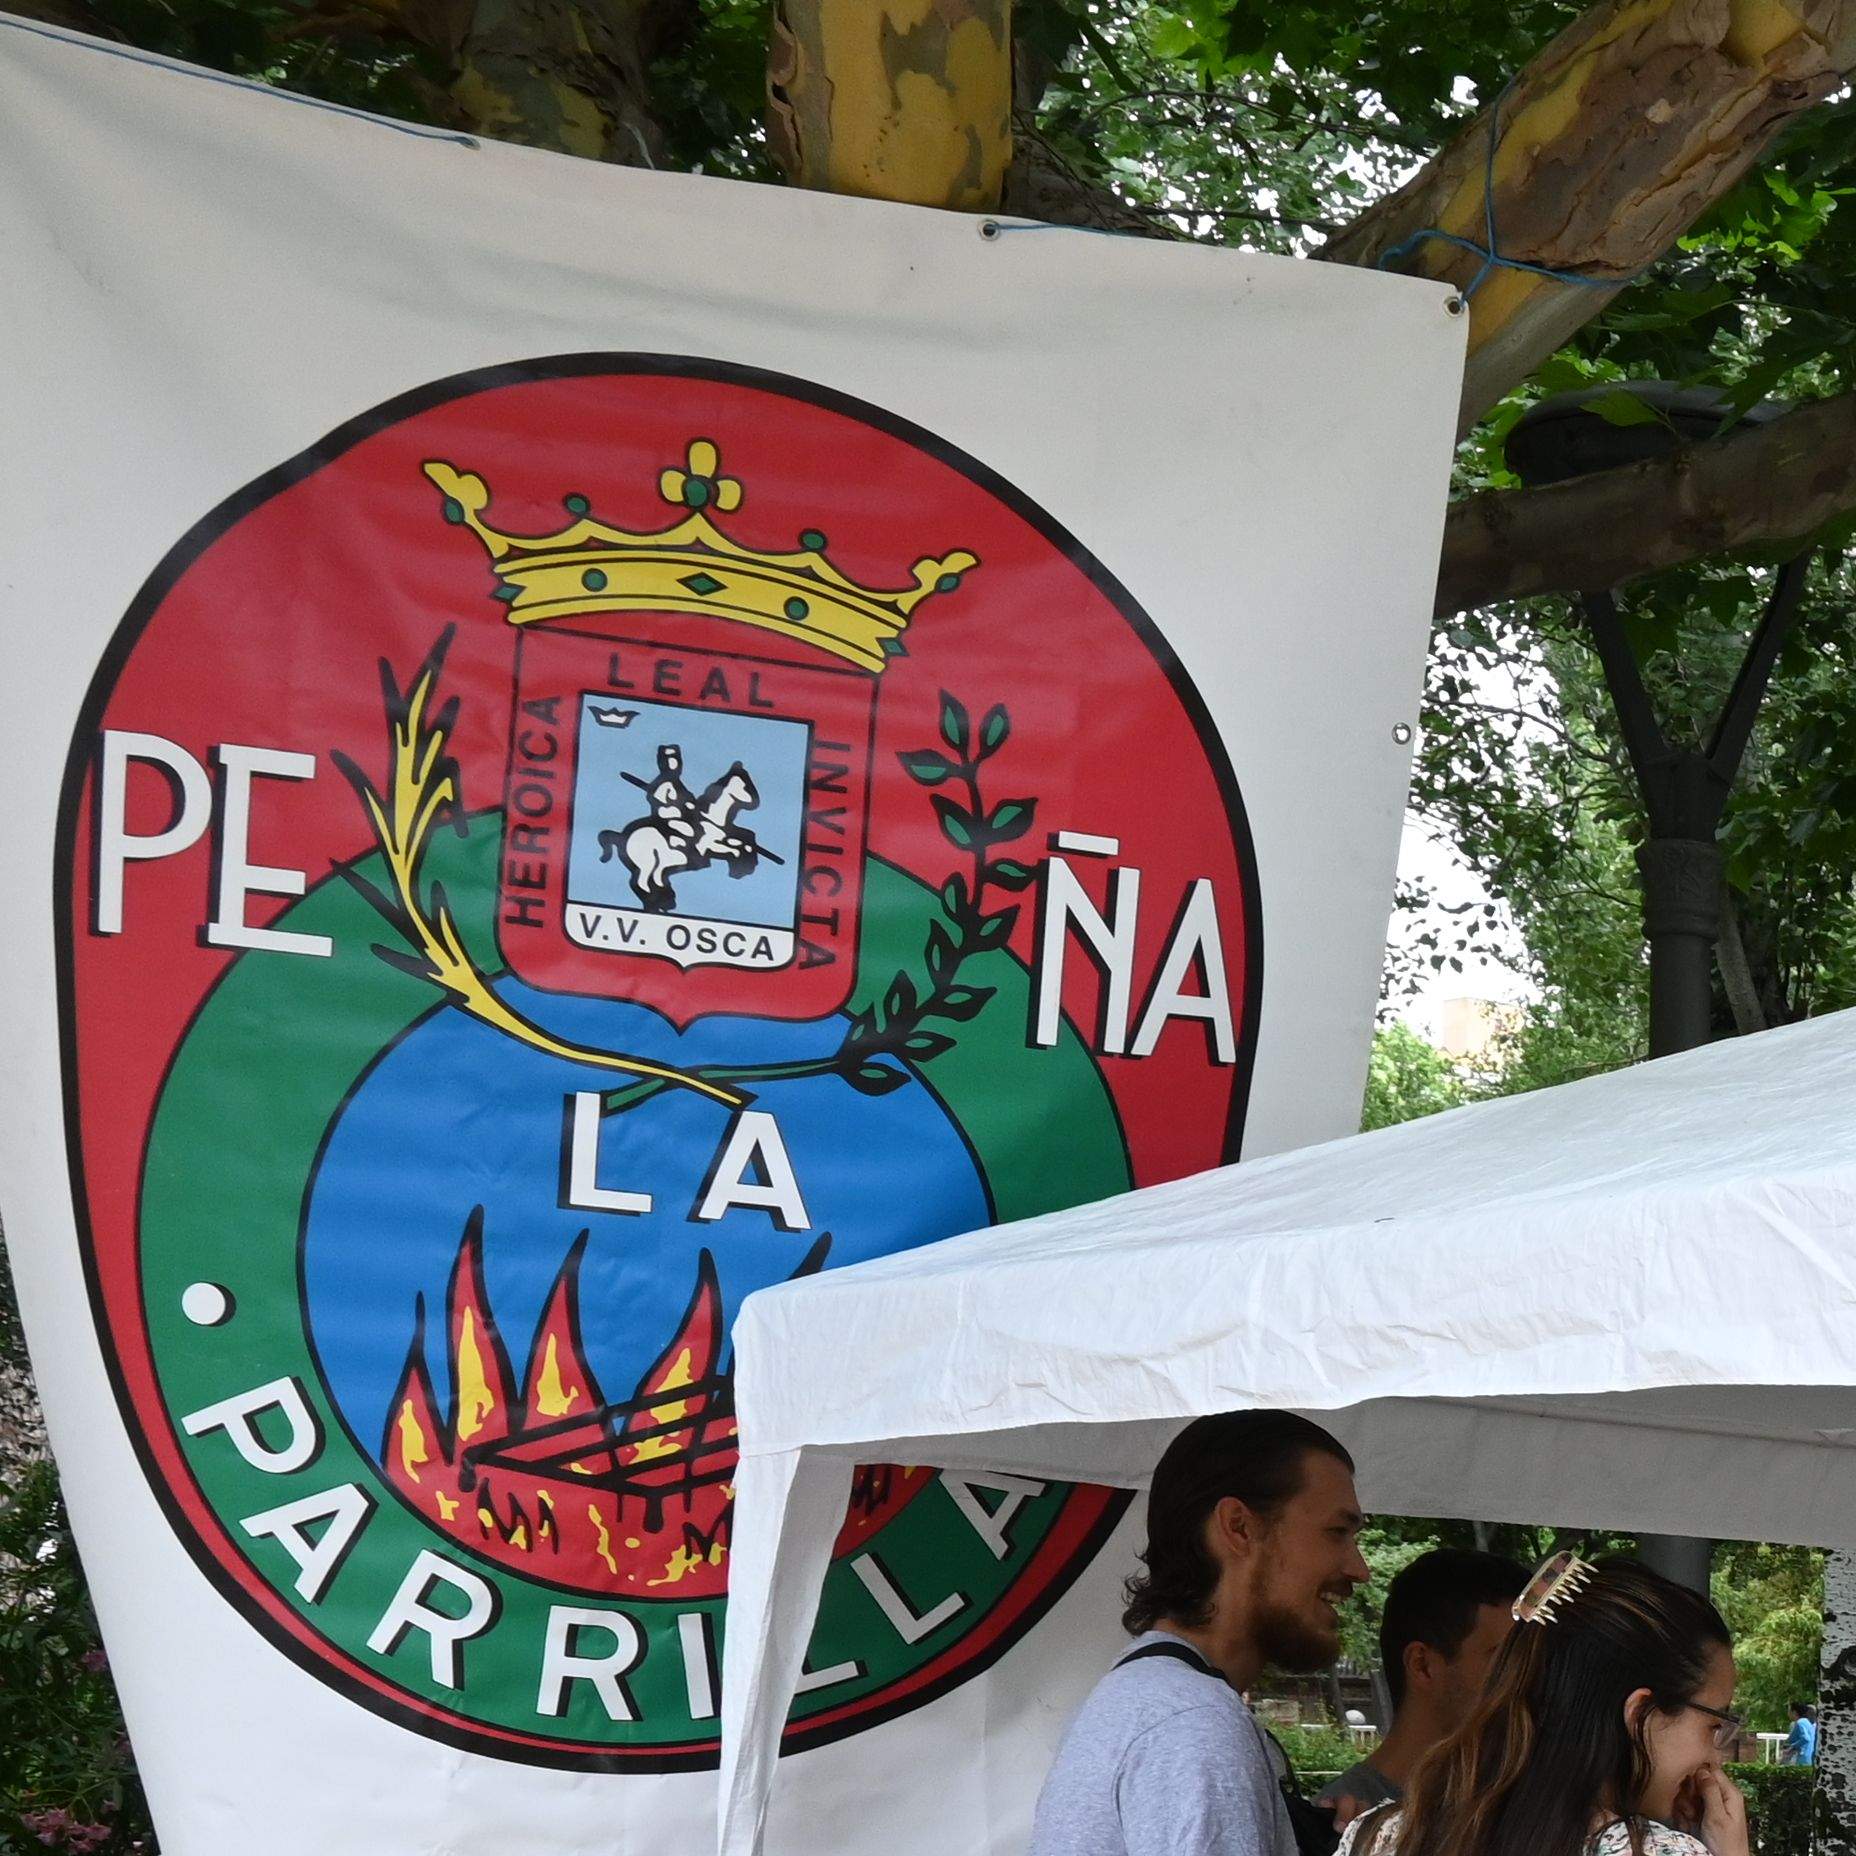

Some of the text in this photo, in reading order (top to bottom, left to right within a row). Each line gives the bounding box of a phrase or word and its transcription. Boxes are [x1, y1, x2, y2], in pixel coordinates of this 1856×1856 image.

[608, 651, 773, 709] LEAL
[95, 730, 1238, 1065] PE ÑA
[504, 694, 561, 929] HEROICA
[800, 736, 853, 972] INVICTA
[578, 913, 776, 962] V.V. OSCA
[559, 1088, 812, 1233] LA
